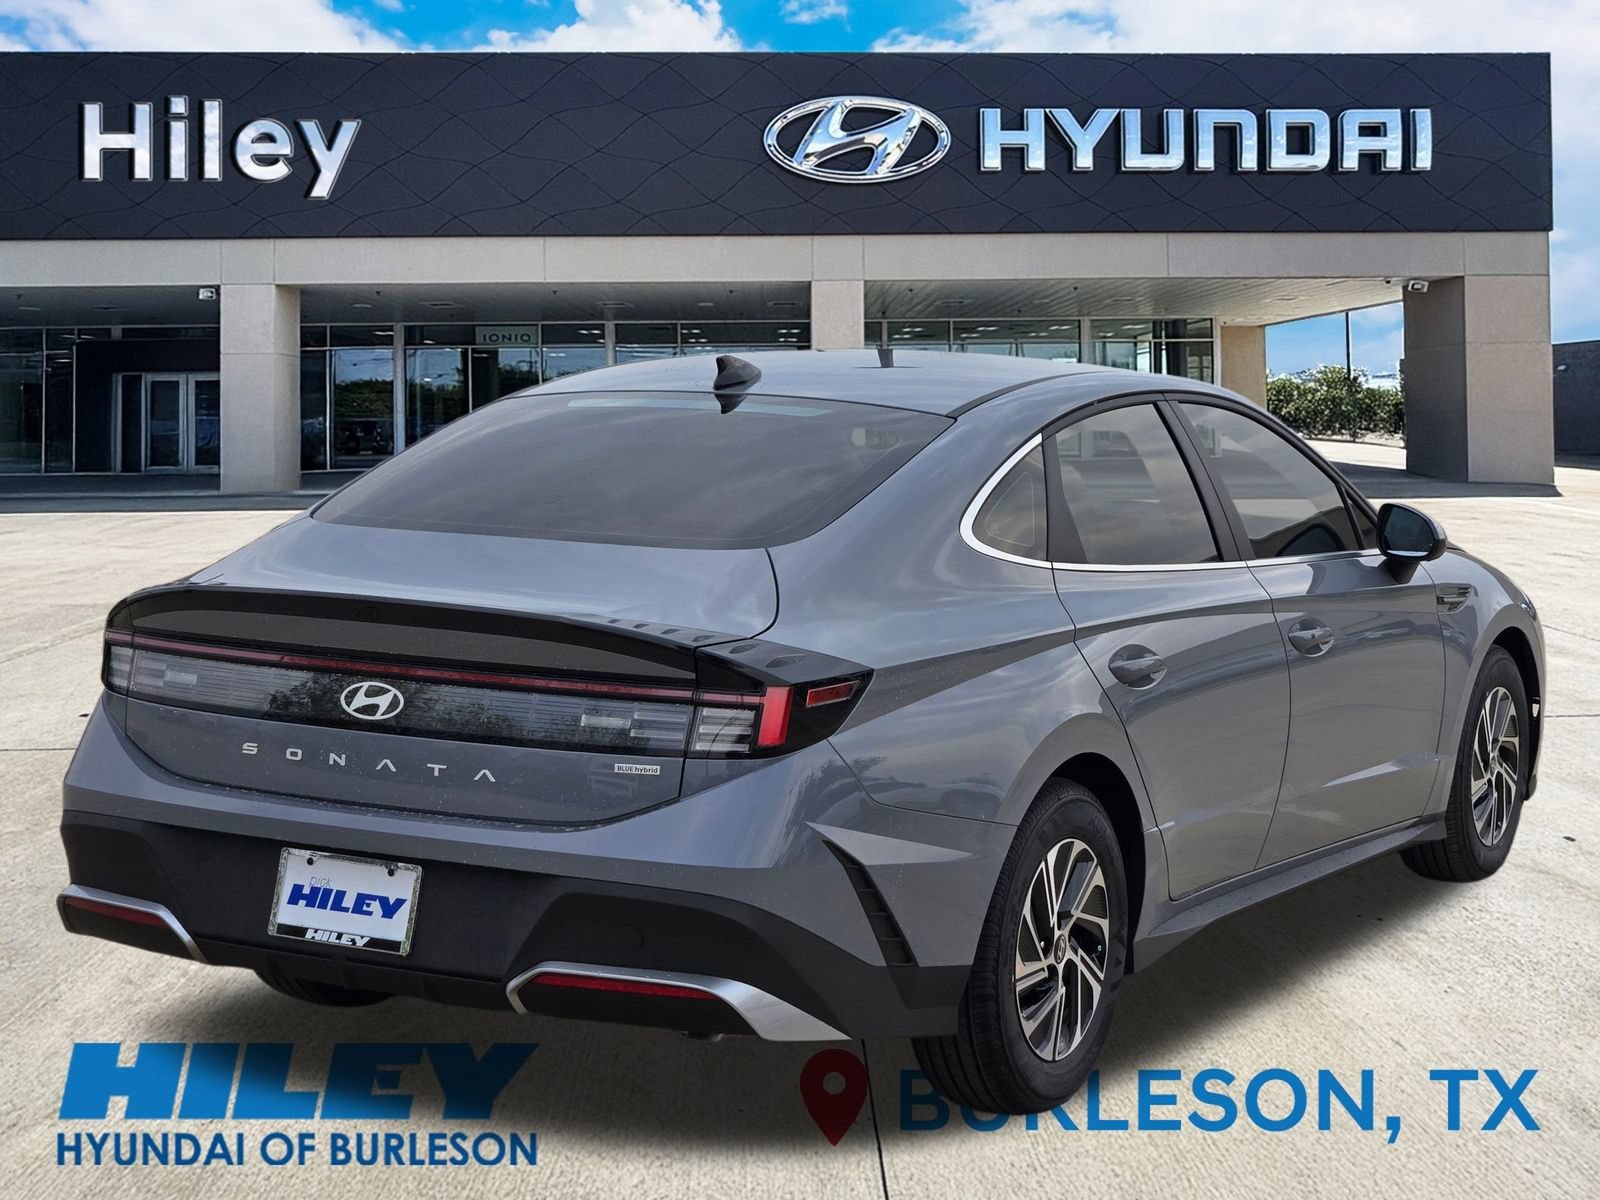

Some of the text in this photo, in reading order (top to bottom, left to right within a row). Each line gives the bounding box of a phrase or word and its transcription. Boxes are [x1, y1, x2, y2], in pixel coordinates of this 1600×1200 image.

[80, 95, 361, 199] Hiley
[979, 107, 1432, 172] HYUNDAI
[241, 742, 497, 783] SONATA
[286, 883, 408, 920] HILEY
[304, 928, 371, 947] HILEY
